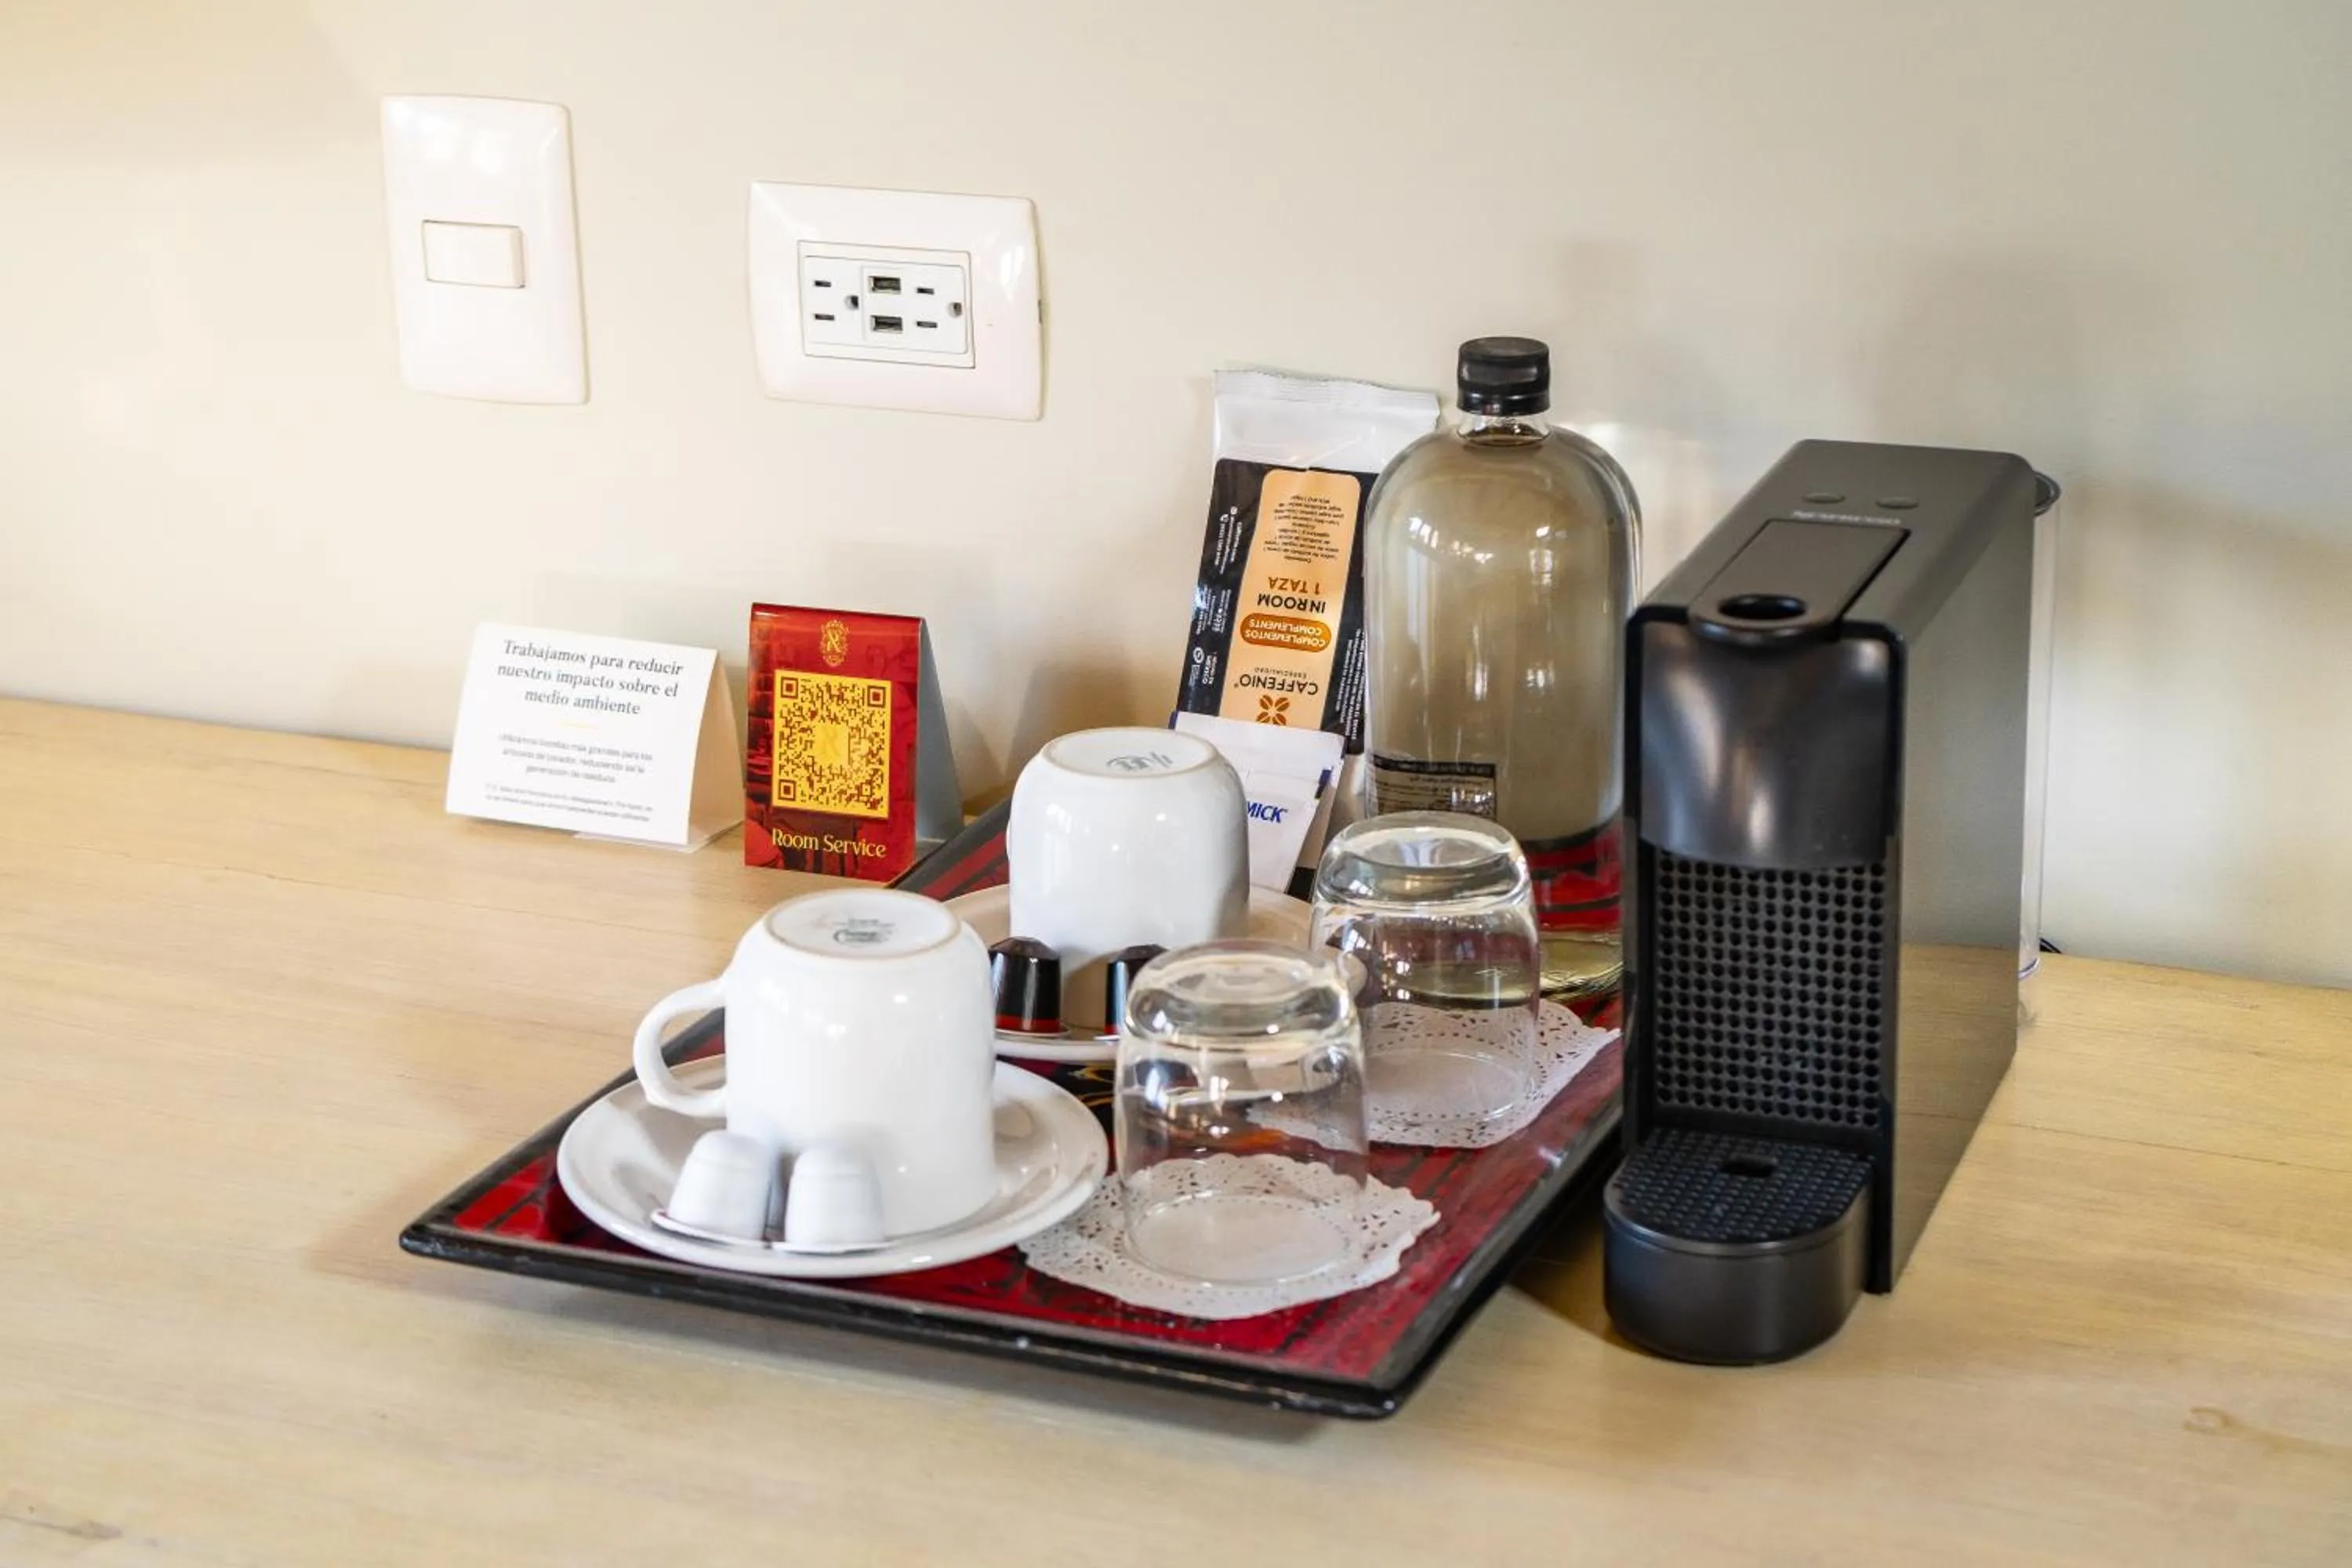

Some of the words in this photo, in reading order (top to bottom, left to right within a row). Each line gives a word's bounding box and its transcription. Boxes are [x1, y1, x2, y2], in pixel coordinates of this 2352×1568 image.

[1268, 576, 1308, 594] TAZA
[1245, 630, 1327, 648] COMPLEMENTOS
[1249, 619, 1323, 636] COMPLEMENTS
[503, 639, 586, 662] Trabajamos
[590, 653, 624, 669] para
[628, 658, 684, 675] reducir
[498, 664, 552, 681] nuestro
[556, 669, 615, 689] impacto
[619, 678, 660, 695] sobre
[664, 682, 679, 697] el
[524, 689, 569, 706] medio
[573, 695, 641, 715] ambiente
[1246, 800, 1283, 823] MICK
[772, 827, 819, 851] Room
[823, 833, 887, 858] Service
